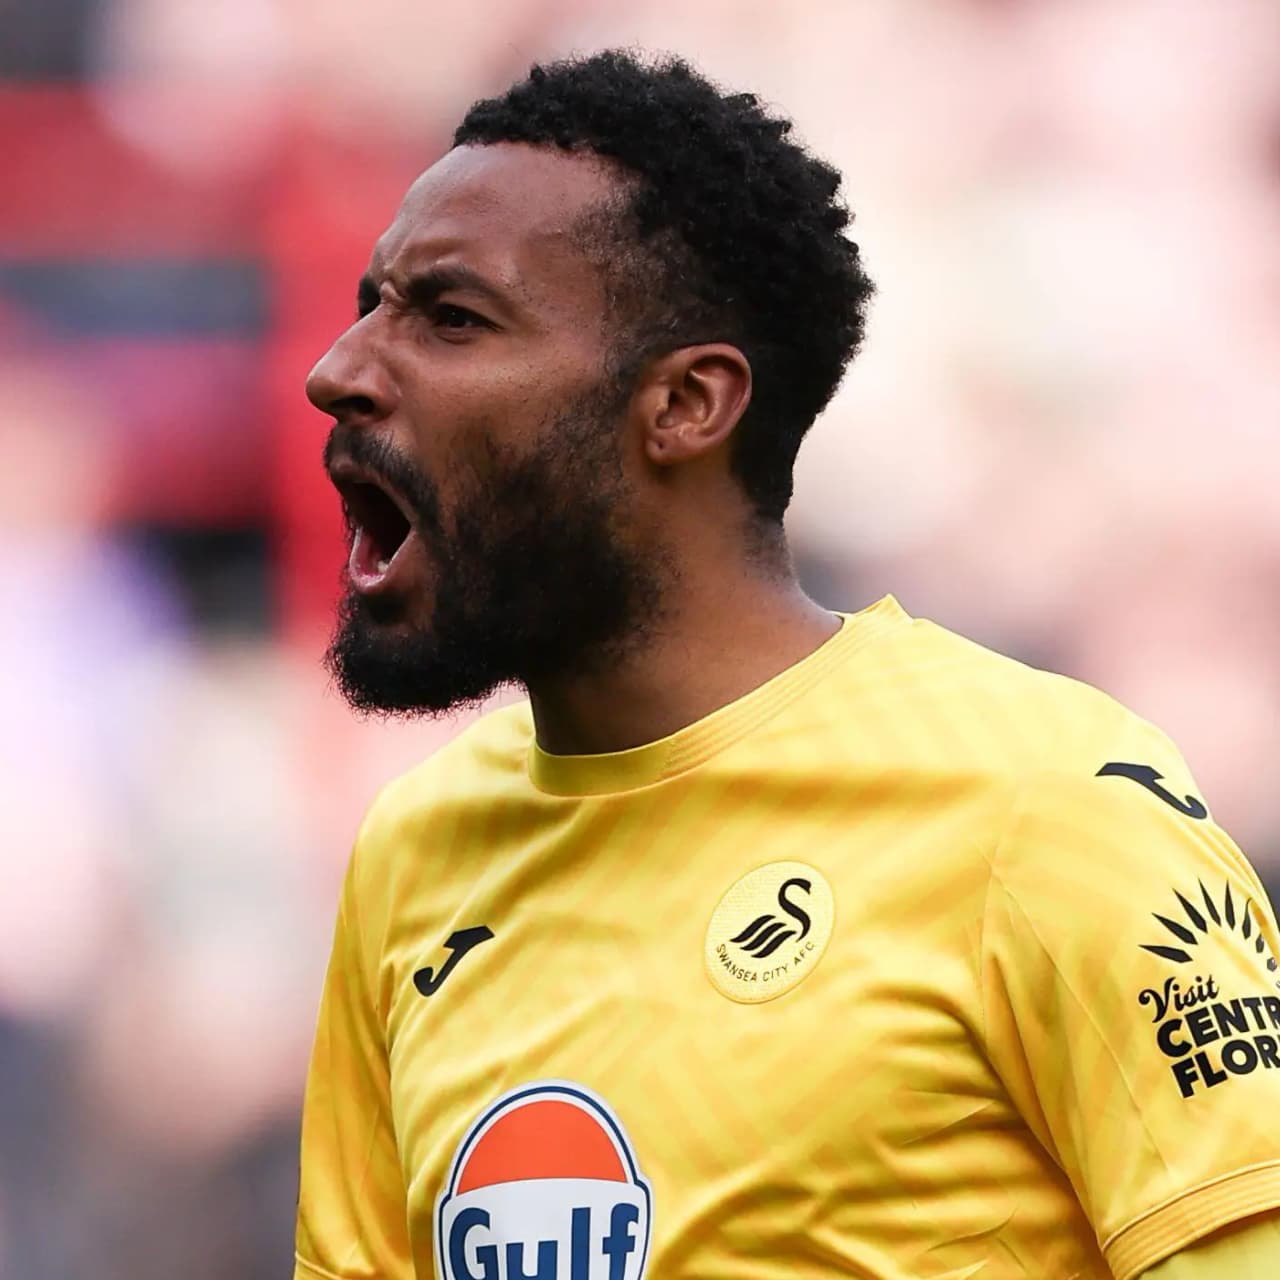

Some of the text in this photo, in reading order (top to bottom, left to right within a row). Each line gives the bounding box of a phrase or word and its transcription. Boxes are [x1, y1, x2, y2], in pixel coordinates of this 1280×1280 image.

[716, 941, 816, 982] SWANSEA CITY AFC
[1138, 974, 1220, 1023] Visit
